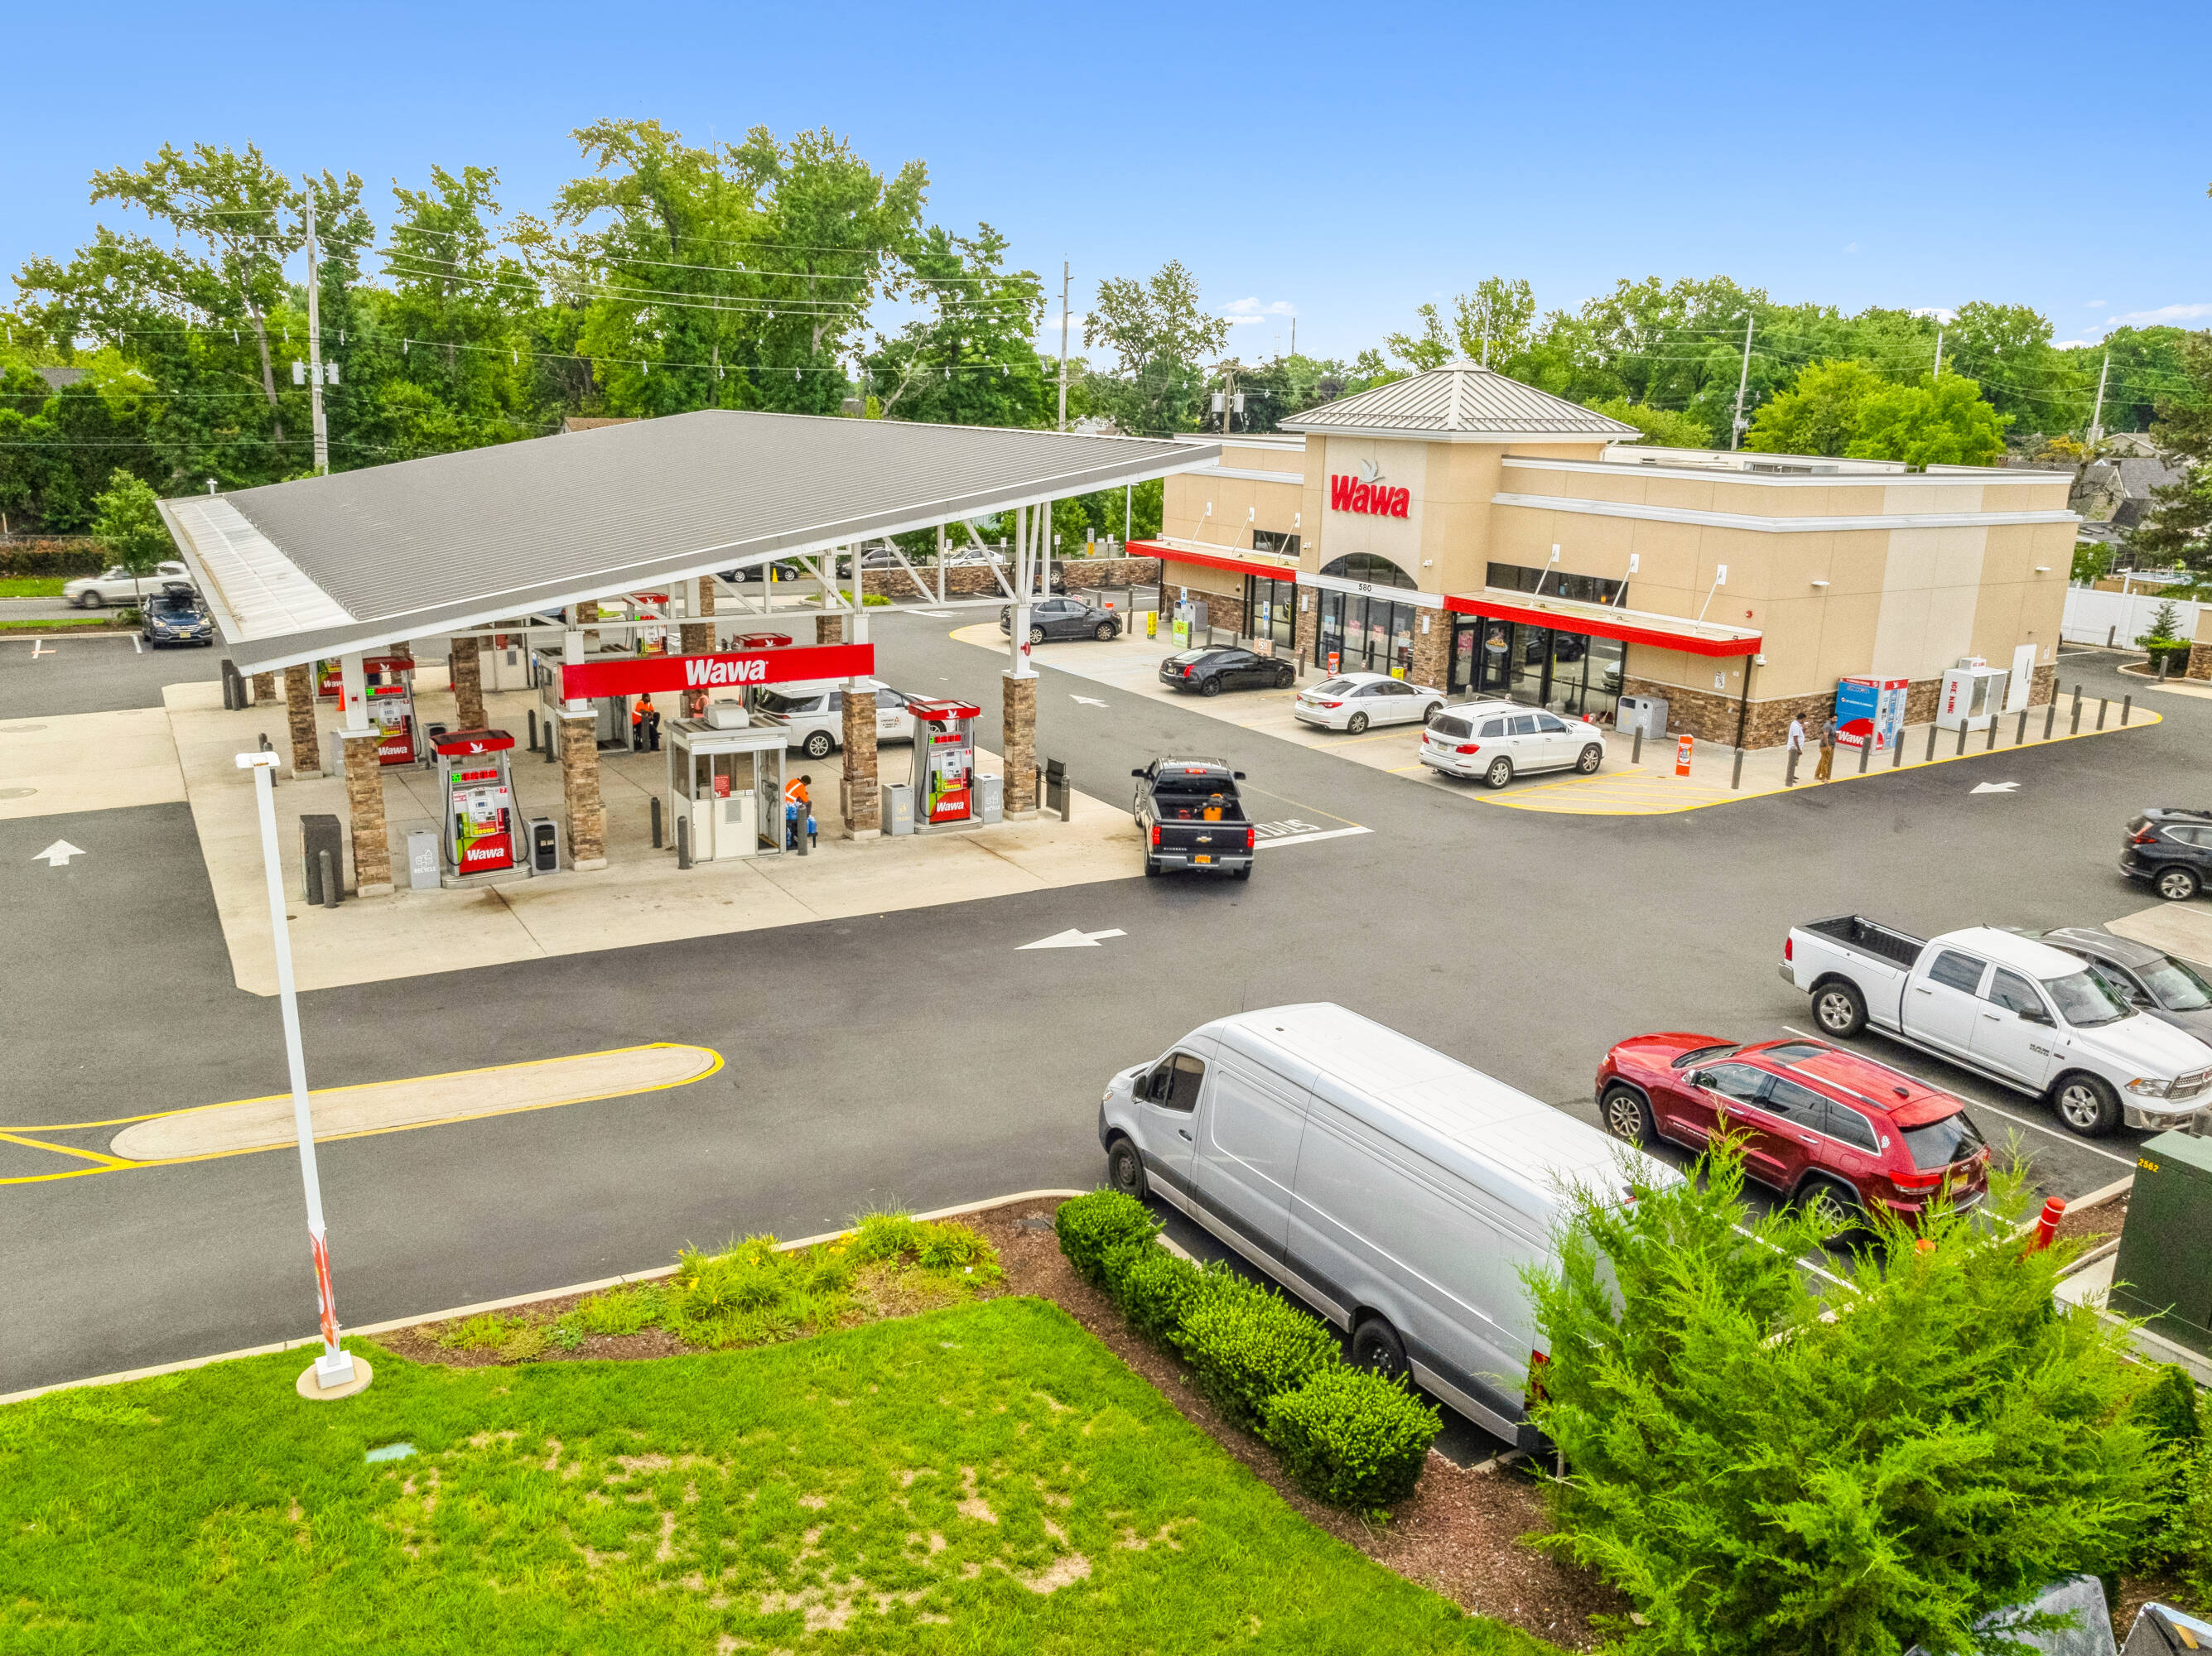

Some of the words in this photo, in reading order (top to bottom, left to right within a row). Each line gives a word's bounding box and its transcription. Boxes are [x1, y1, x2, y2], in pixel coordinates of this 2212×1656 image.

[1331, 474, 1410, 518] Wawa
[1358, 583, 1372, 592] 580
[685, 658, 769, 686] Wawa
[324, 680, 343, 688] Waw
[1949, 681, 1958, 694] ICE
[1947, 696, 1955, 714] KING
[378, 746, 407, 756] Wawa
[937, 802, 964, 812] Wawa
[466, 848, 504, 861] Wawa
[2138, 1158, 2159, 1172] 2562
